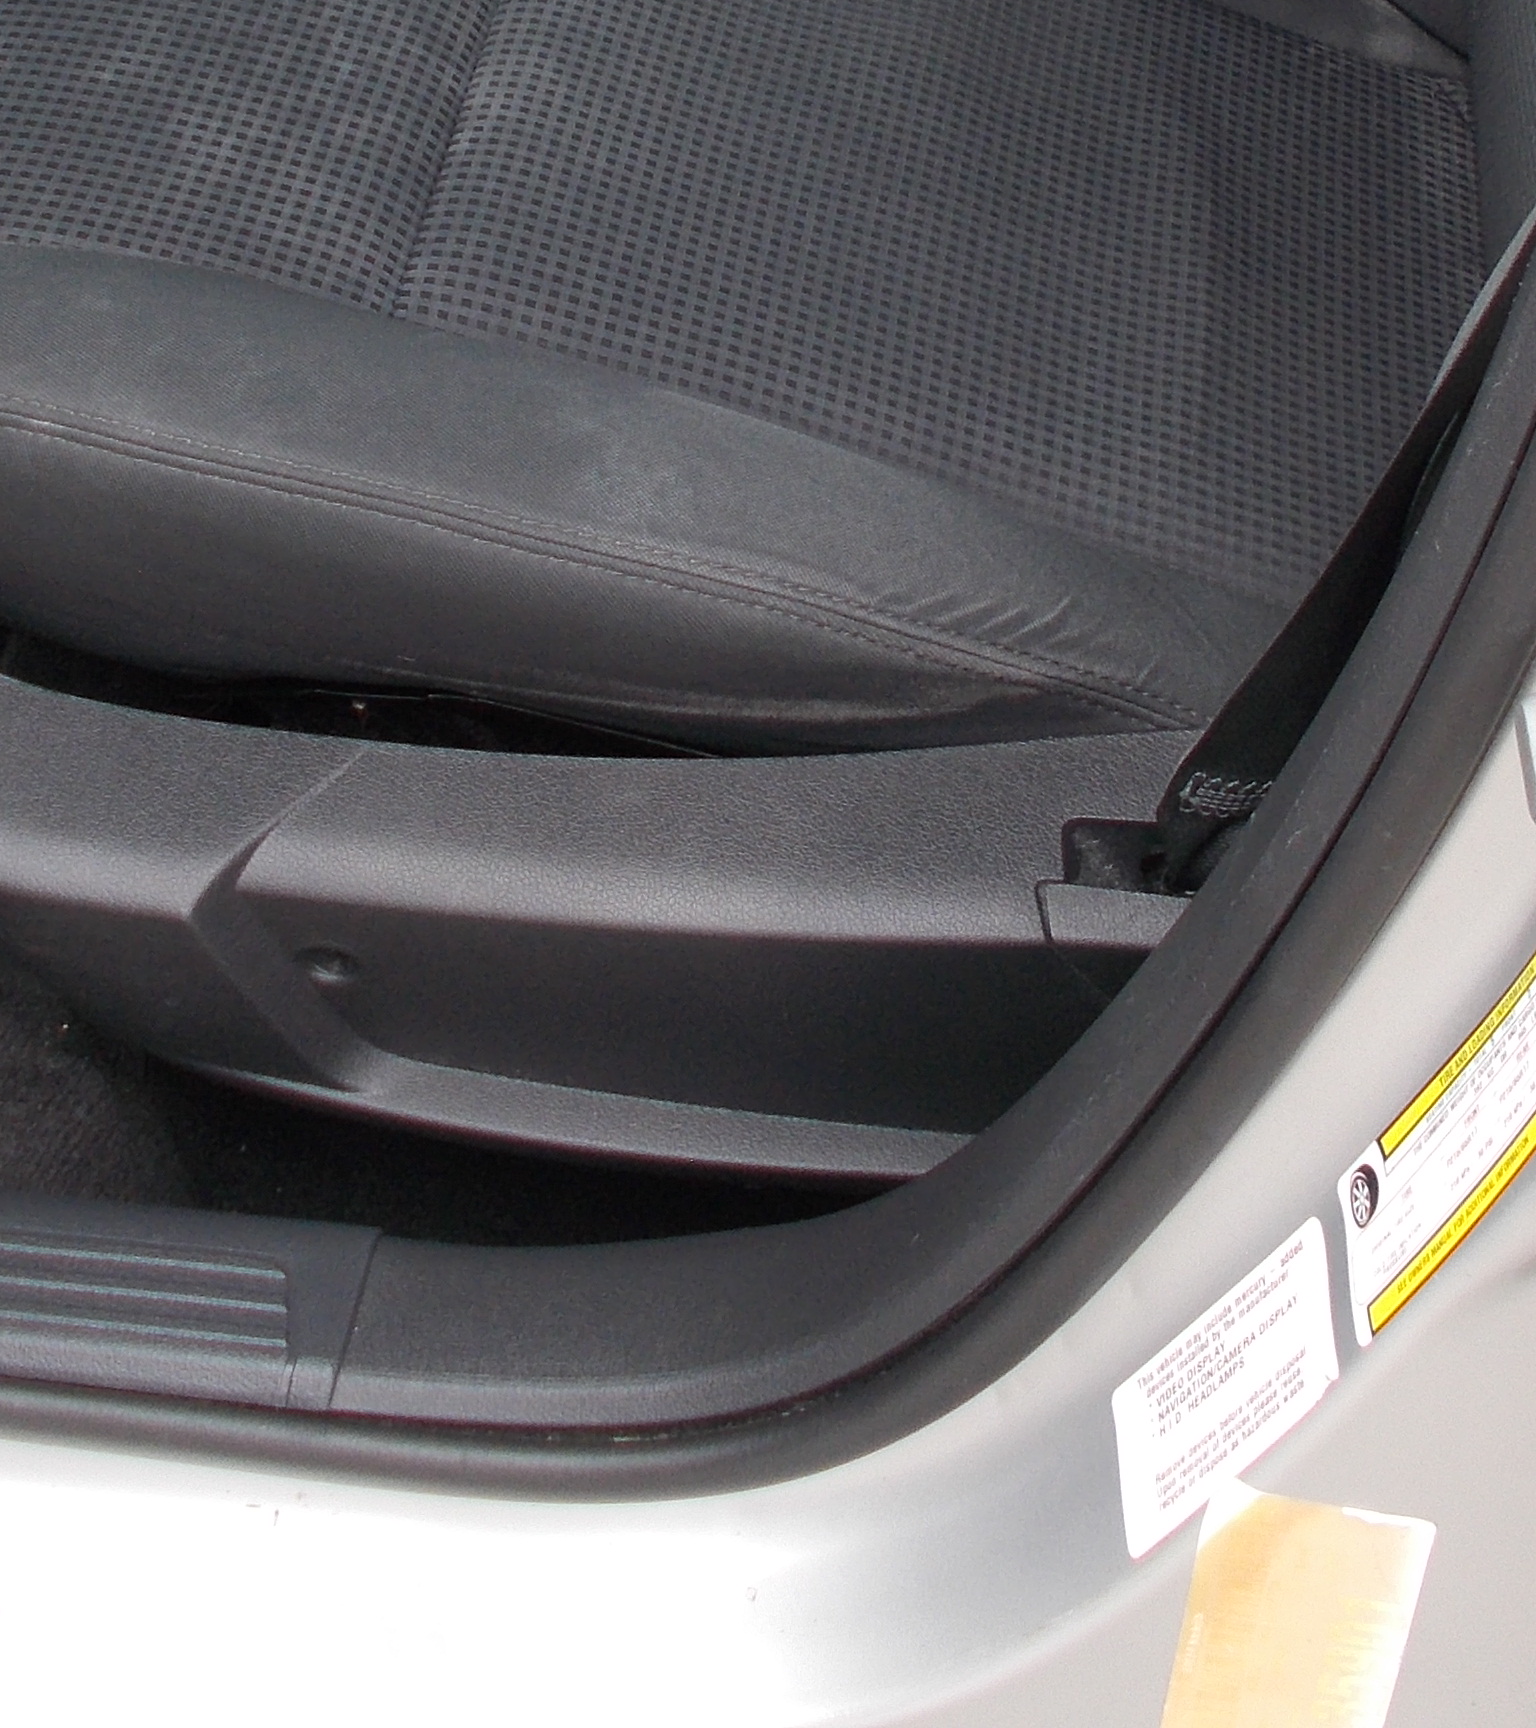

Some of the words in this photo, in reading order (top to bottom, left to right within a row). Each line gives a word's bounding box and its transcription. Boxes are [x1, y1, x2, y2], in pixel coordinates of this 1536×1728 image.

[1438, 1065, 1455, 1088] TIRE
[1454, 1048, 1469, 1071] AND
[1467, 1011, 1496, 1055] LOADING
[1493, 963, 1536, 1022] INFORMATION
[1453, 1213, 1465, 1233] FOR
[1136, 1371, 1155, 1390] This
[1155, 1346, 1184, 1375] vehicle
[1185, 1331, 1202, 1350] may
[1203, 1304, 1233, 1335] include
[1234, 1275, 1266, 1308] mercury
[1279, 1239, 1304, 1268] added
[1146, 1368, 1175, 1399] devices
[1176, 1336, 1210, 1372] installed
[1211, 1329, 1221, 1342] by
[1222, 1316, 1236, 1332] the
[1238, 1268, 1289, 1319] manufacturer
[1155, 1376, 1185, 1408] VIDEO
[1186, 1340, 1225, 1382] DISPLAY
[1157, 1331, 1257, 1423] NAVIGATION/CAMERA
[1258, 1295, 1297, 1336] DISPLAY
[1187, 1355, 1245, 1413] HEADLAMPS
[1245, 1378, 1273, 1408] vehicle
[1179, 1447, 1210, 1480] removal
[1222, 1413, 1251, 1444] devices
[1253, 1388, 1278, 1419] please
[1198, 1447, 1228, 1479] dispose
[1230, 1437, 1240, 1452] as
[1241, 1401, 1281, 1441] hazardous
